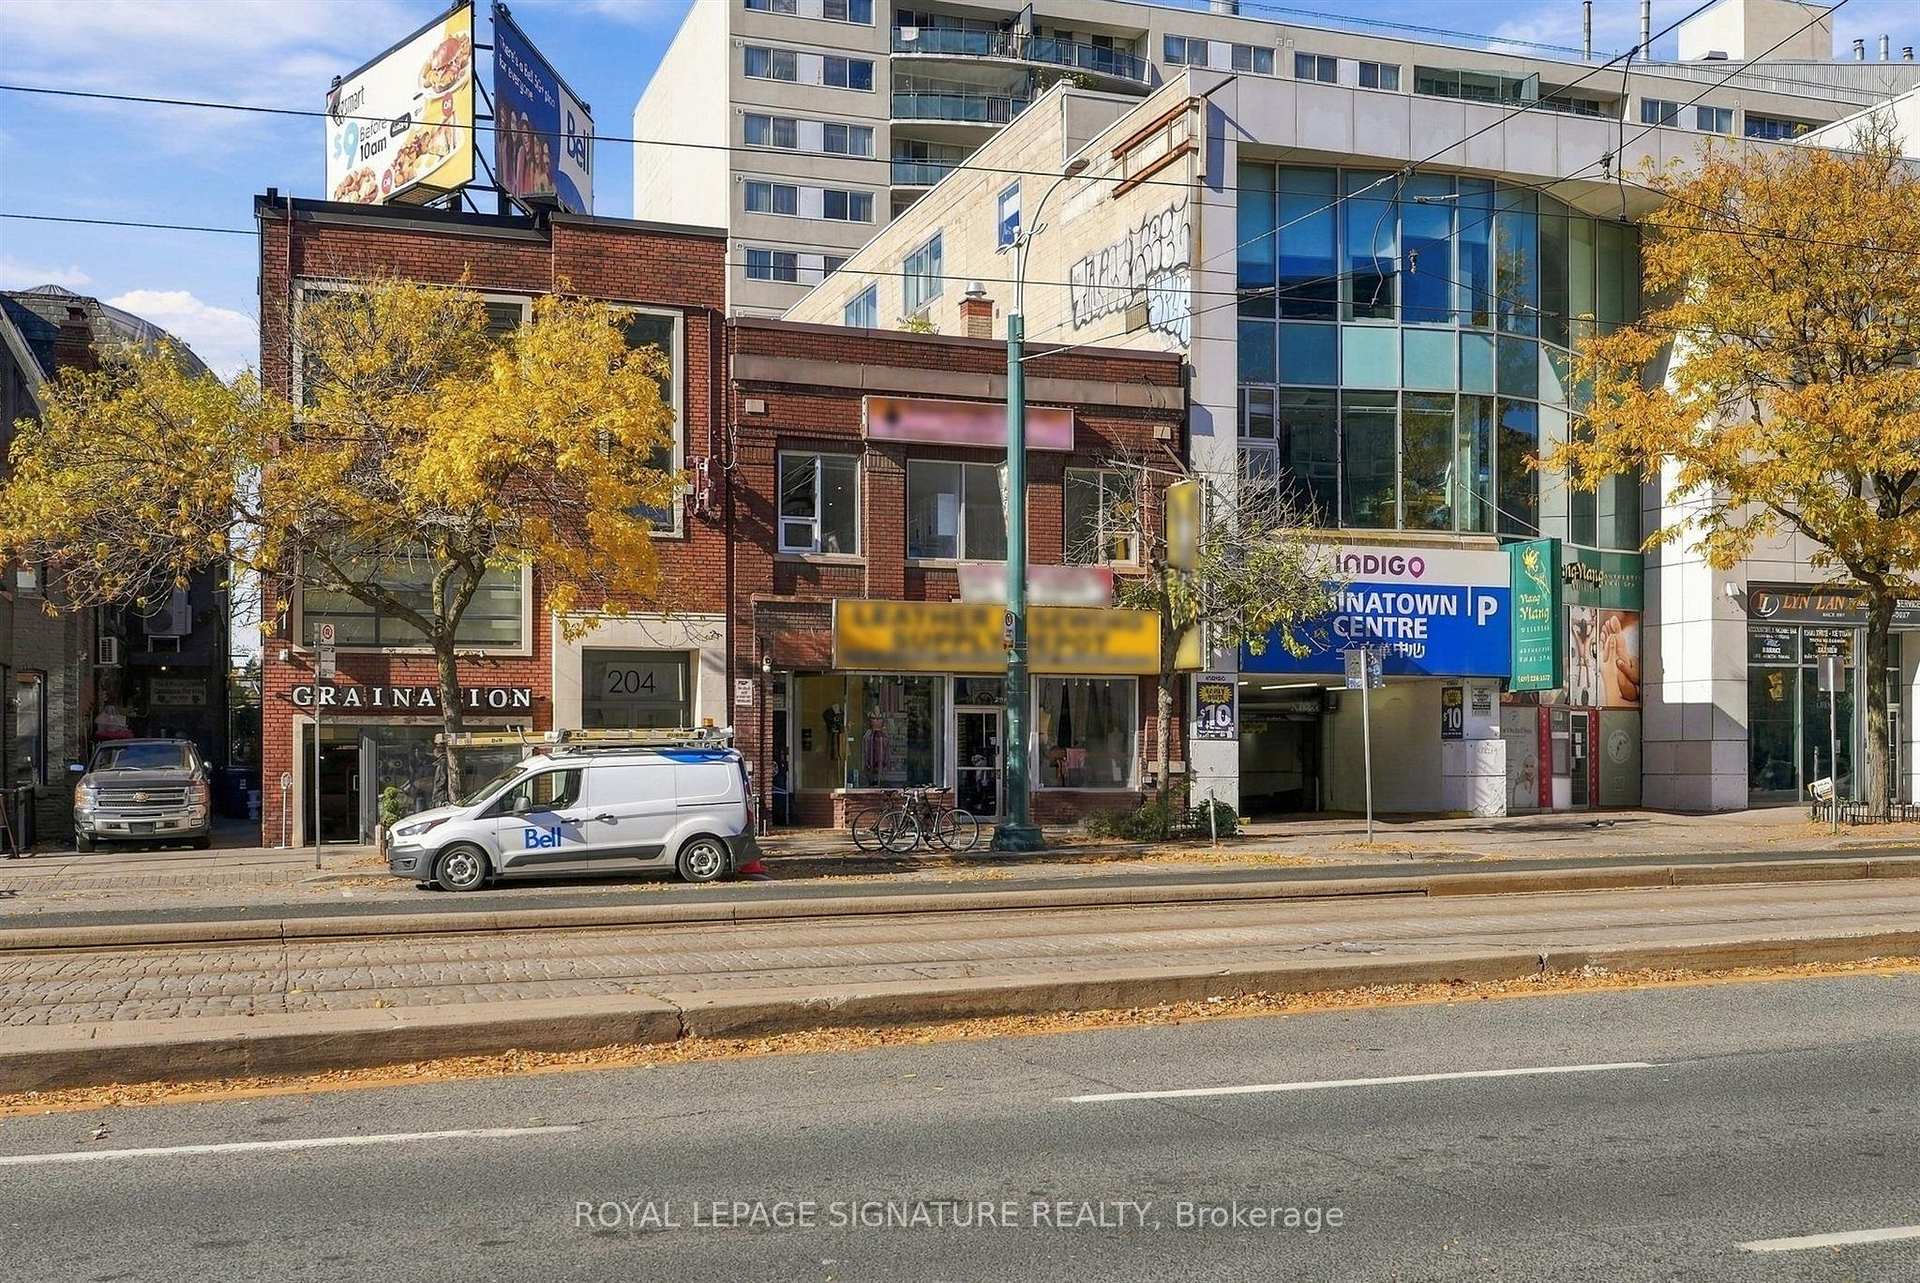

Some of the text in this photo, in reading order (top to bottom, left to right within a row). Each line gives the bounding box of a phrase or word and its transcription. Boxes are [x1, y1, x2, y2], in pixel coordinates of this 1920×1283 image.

[360, 136, 387, 162] 10am
[566, 109, 590, 176] Bell
[1337, 591, 1498, 627] INATOWN P
[1782, 593, 1810, 609] LYN
[1816, 595, 1846, 611] LAN
[1519, 606, 1550, 624] Ylang
[1333, 615, 1428, 640] CENTRE
[607, 669, 656, 694] 204
[292, 686, 532, 708] GRAINAION
[1200, 704, 1232, 728] $10
[1443, 707, 1462, 729] $10
[524, 827, 562, 849] Bell
